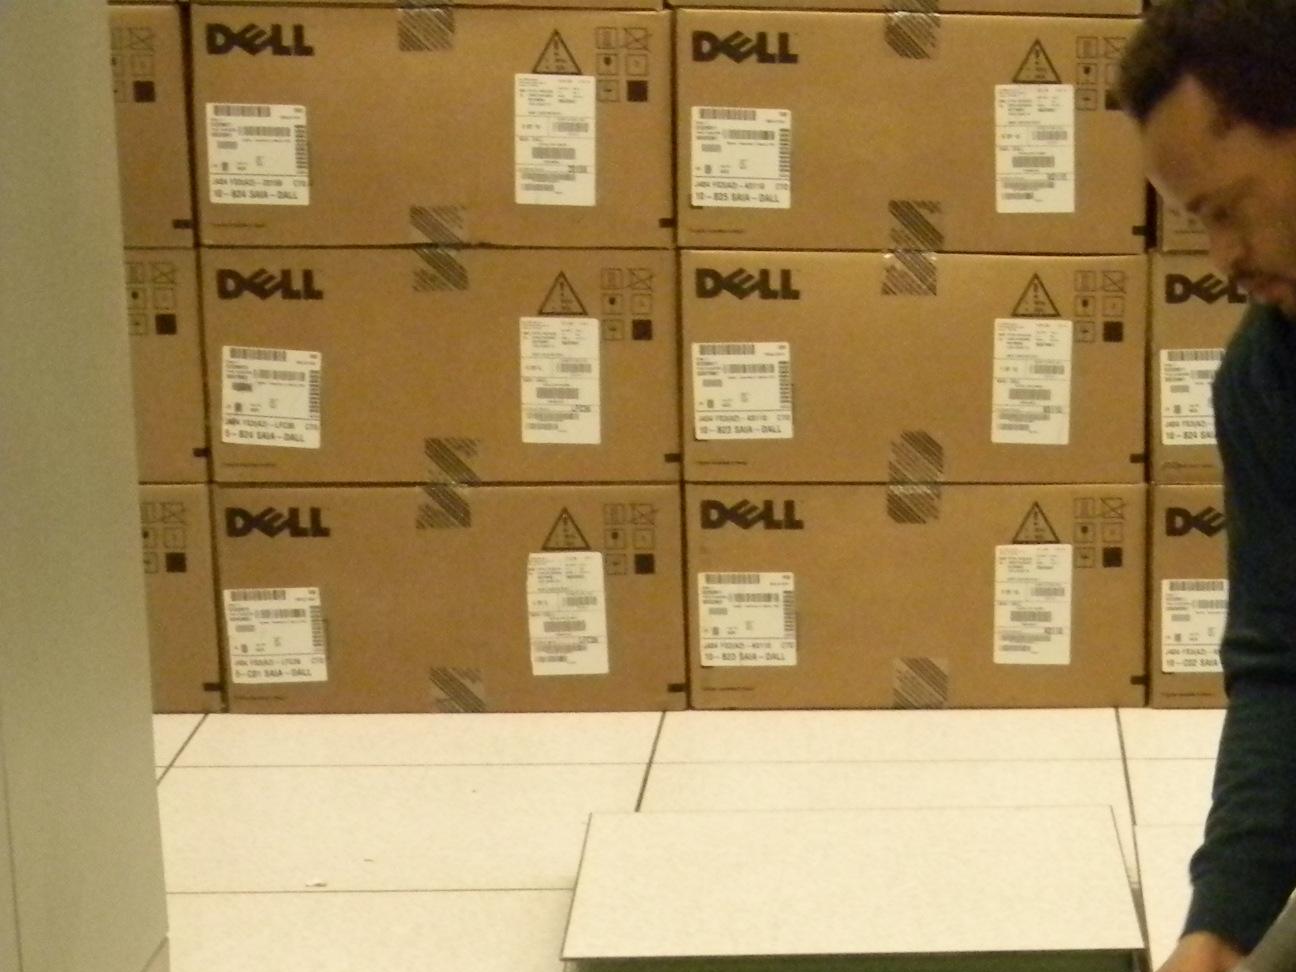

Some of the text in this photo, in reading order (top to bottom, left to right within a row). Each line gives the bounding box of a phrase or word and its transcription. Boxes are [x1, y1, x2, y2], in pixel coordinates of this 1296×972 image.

[206, 23, 314, 57] DELL
[692, 31, 799, 64] DELL
[217, 268, 323, 300] DELL
[696, 268, 801, 301] DELL
[1165, 272, 1248, 304] DEL
[225, 506, 330, 537] DELL
[701, 499, 804, 530] DELL
[1165, 506, 1227, 537] DE
